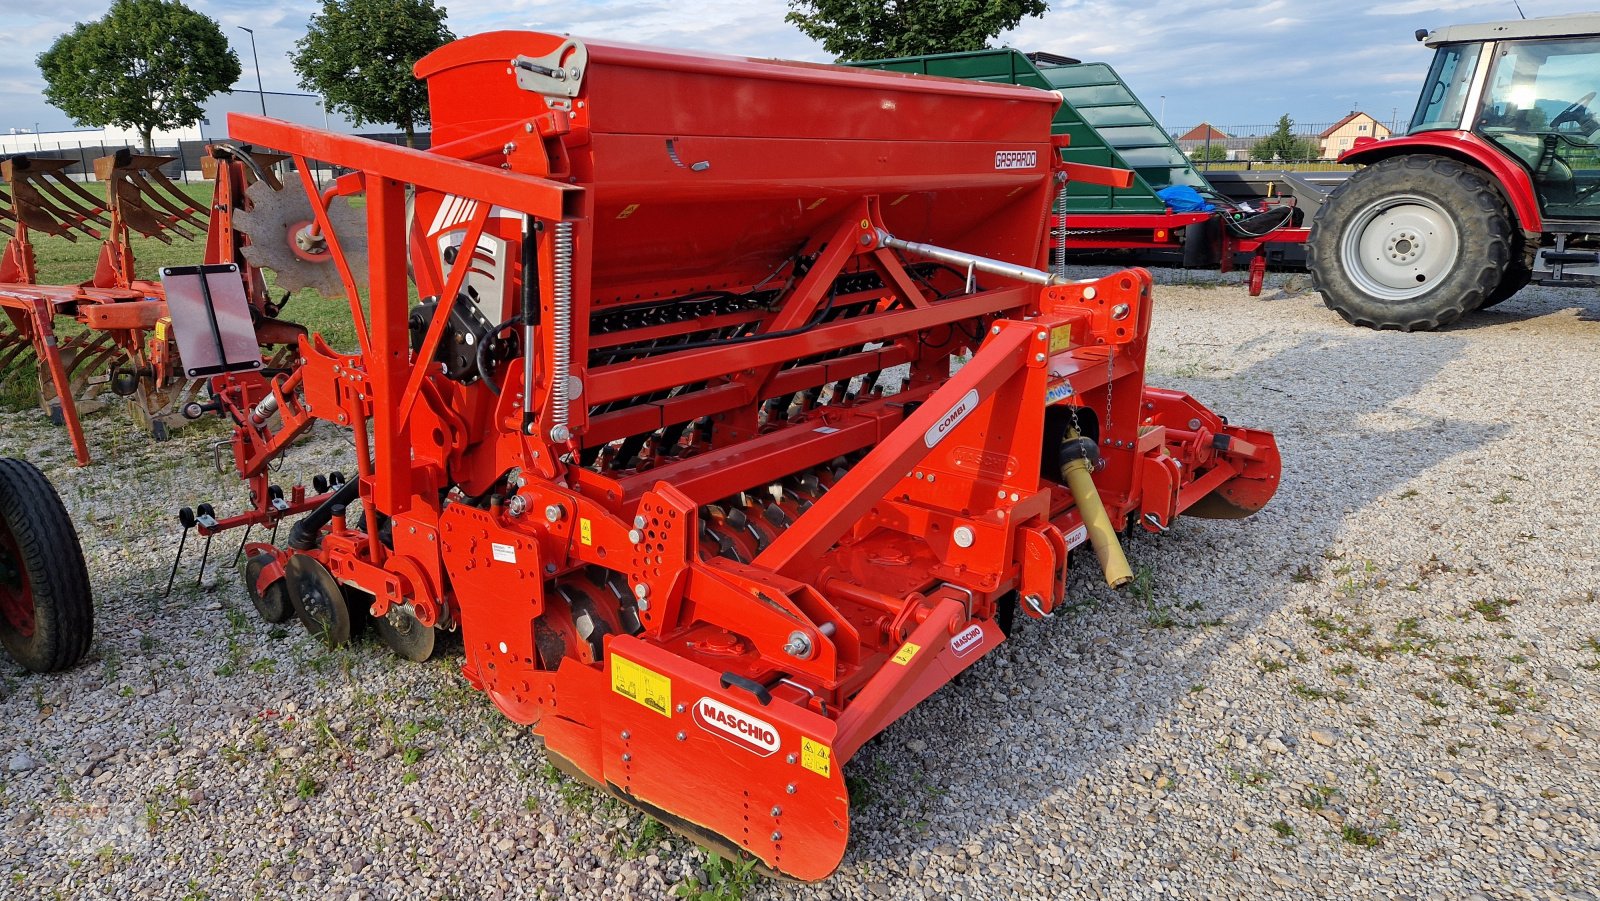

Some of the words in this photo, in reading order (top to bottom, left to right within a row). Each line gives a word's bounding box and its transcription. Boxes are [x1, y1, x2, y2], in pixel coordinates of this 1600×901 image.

[996, 152, 1036, 167] GASPARDO
[938, 403, 966, 432] COMBI
[953, 628, 981, 648] MASCHIO
[704, 703, 775, 745] MASCHIO
